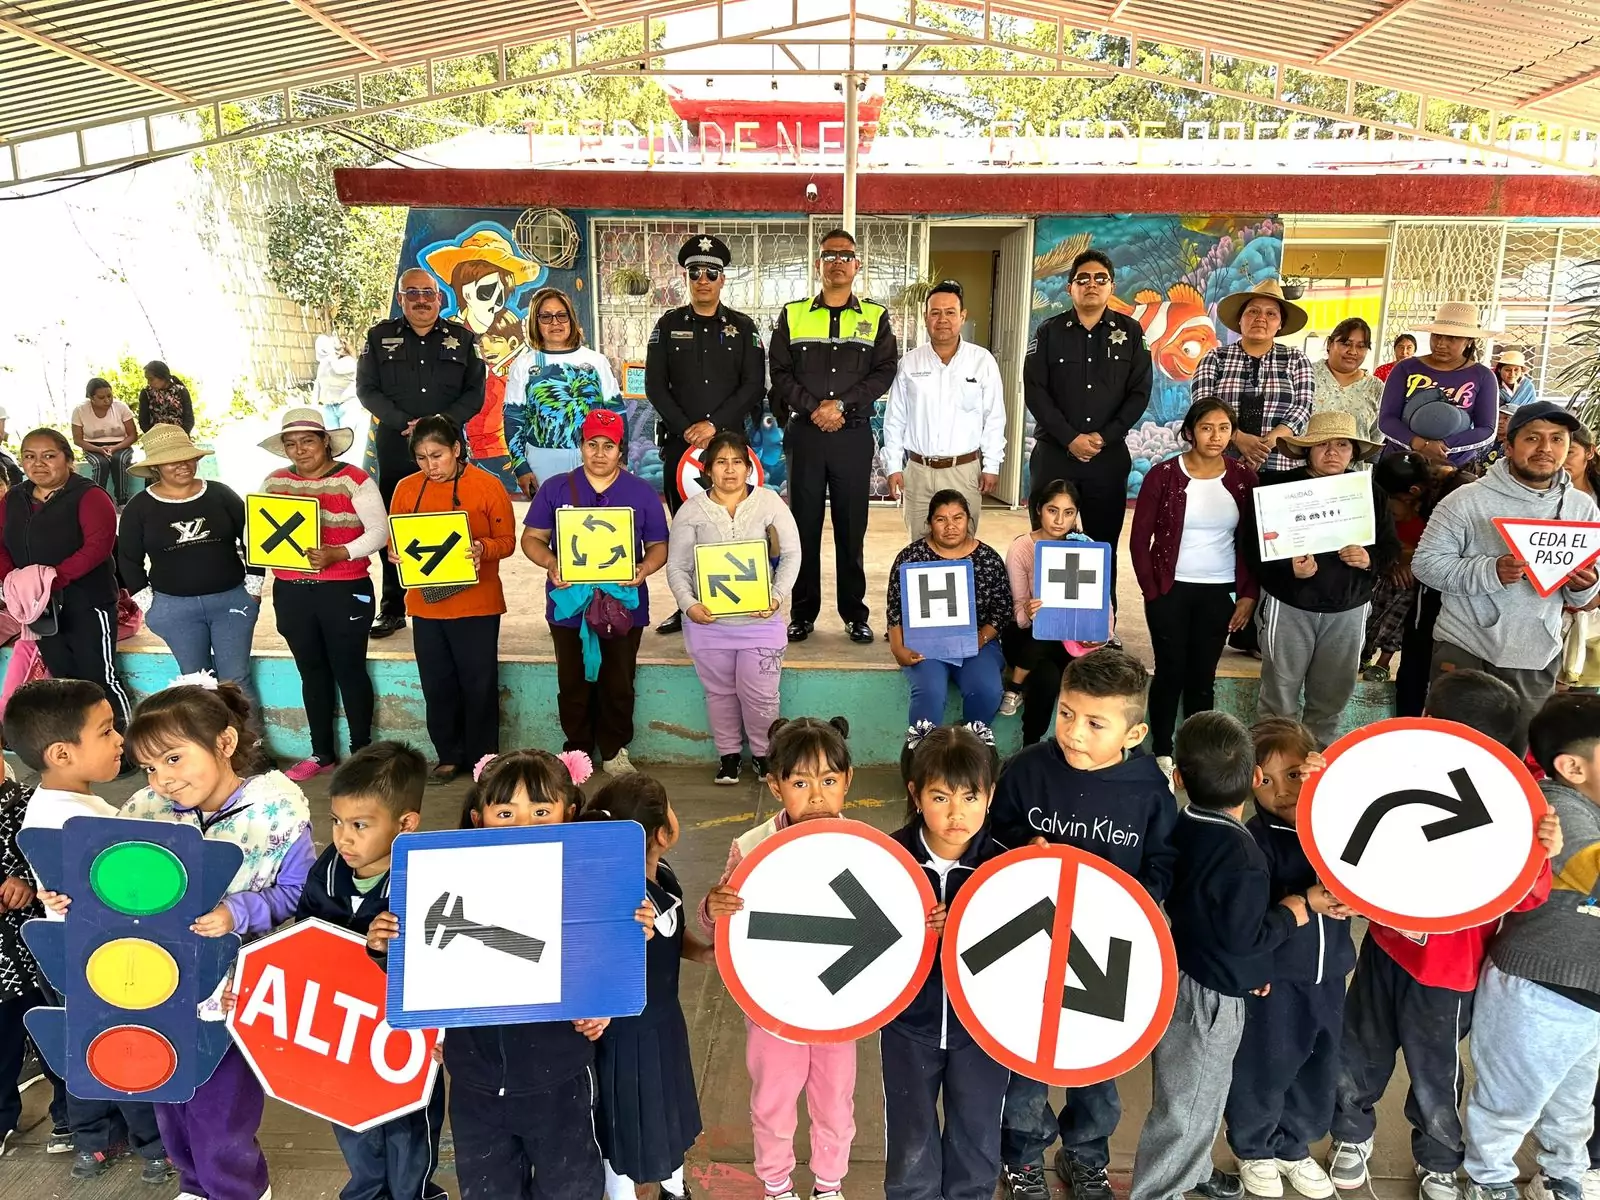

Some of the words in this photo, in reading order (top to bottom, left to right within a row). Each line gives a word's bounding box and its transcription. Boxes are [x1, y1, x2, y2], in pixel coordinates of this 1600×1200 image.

[1529, 531, 1566, 547] CEDA
[1571, 533, 1587, 548] EL
[1535, 550, 1574, 565] PASO
[918, 572, 957, 618] H
[1027, 806, 1087, 839] Calvin
[1092, 817, 1140, 848] Klein
[239, 963, 427, 1085] ALTO
